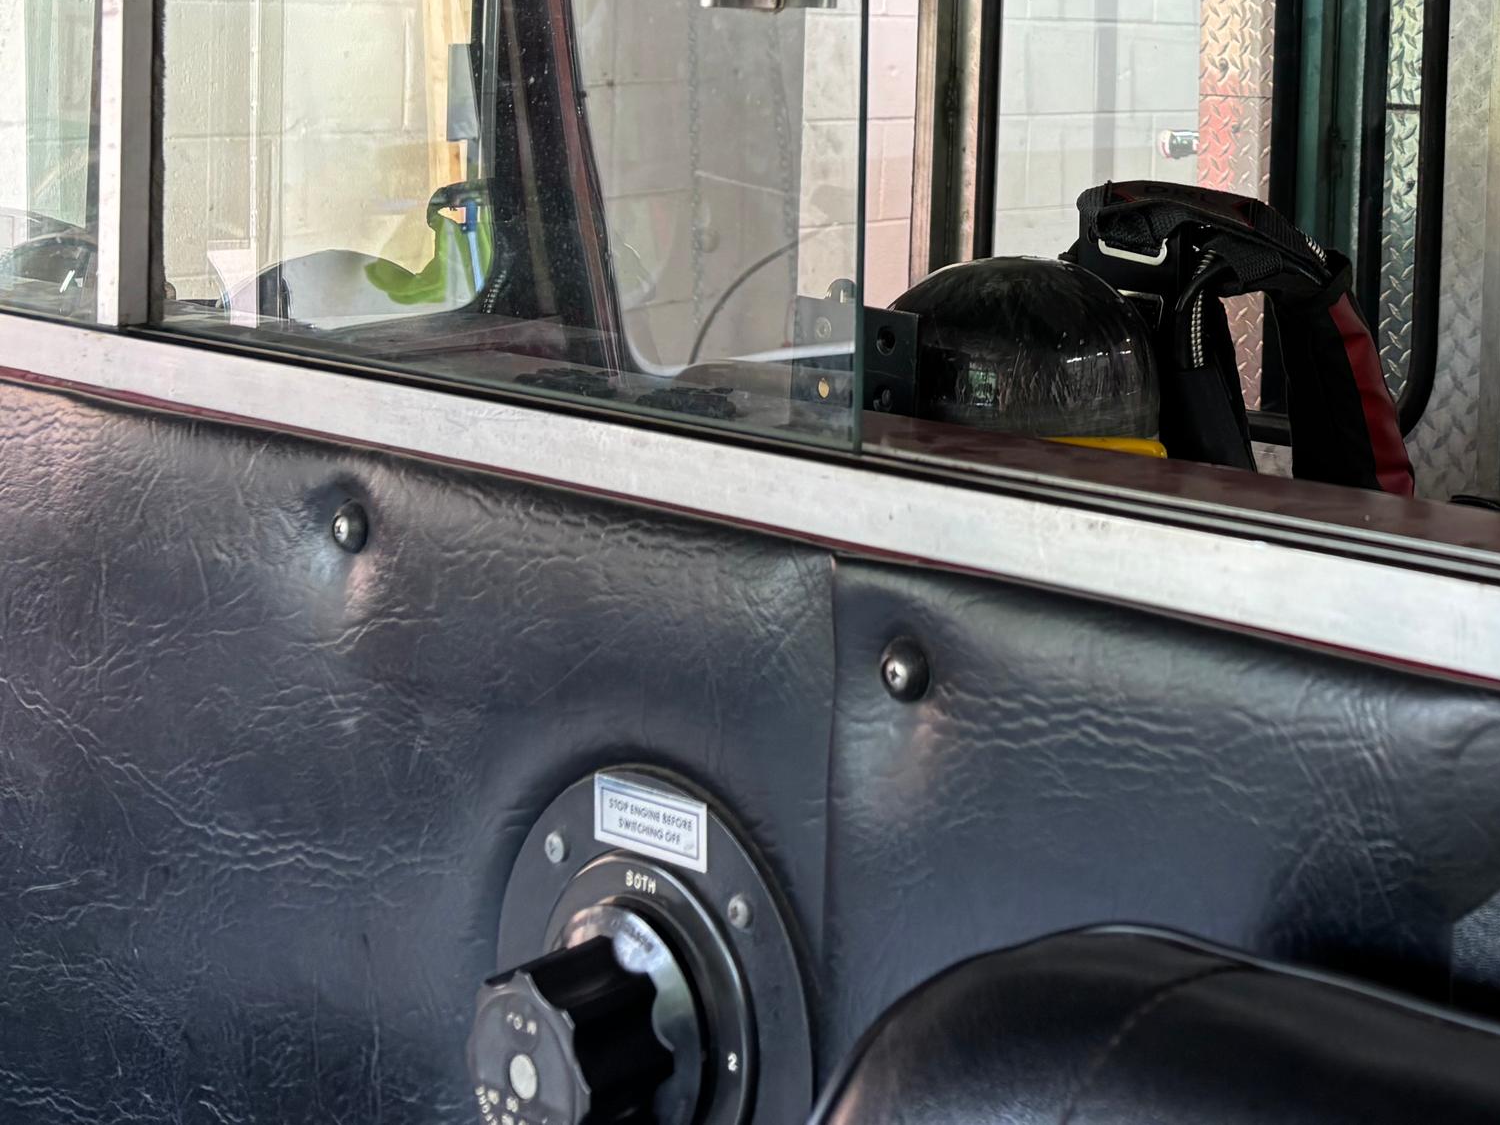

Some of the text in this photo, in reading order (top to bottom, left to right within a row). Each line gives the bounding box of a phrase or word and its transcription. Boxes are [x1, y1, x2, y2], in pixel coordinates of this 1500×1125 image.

[608, 798, 693, 832] STOP ENGINE BEFORE
[618, 818, 681, 845] SWITCHING OFF
[625, 869, 657, 895] BOTH
[727, 1051, 739, 1072] 2
